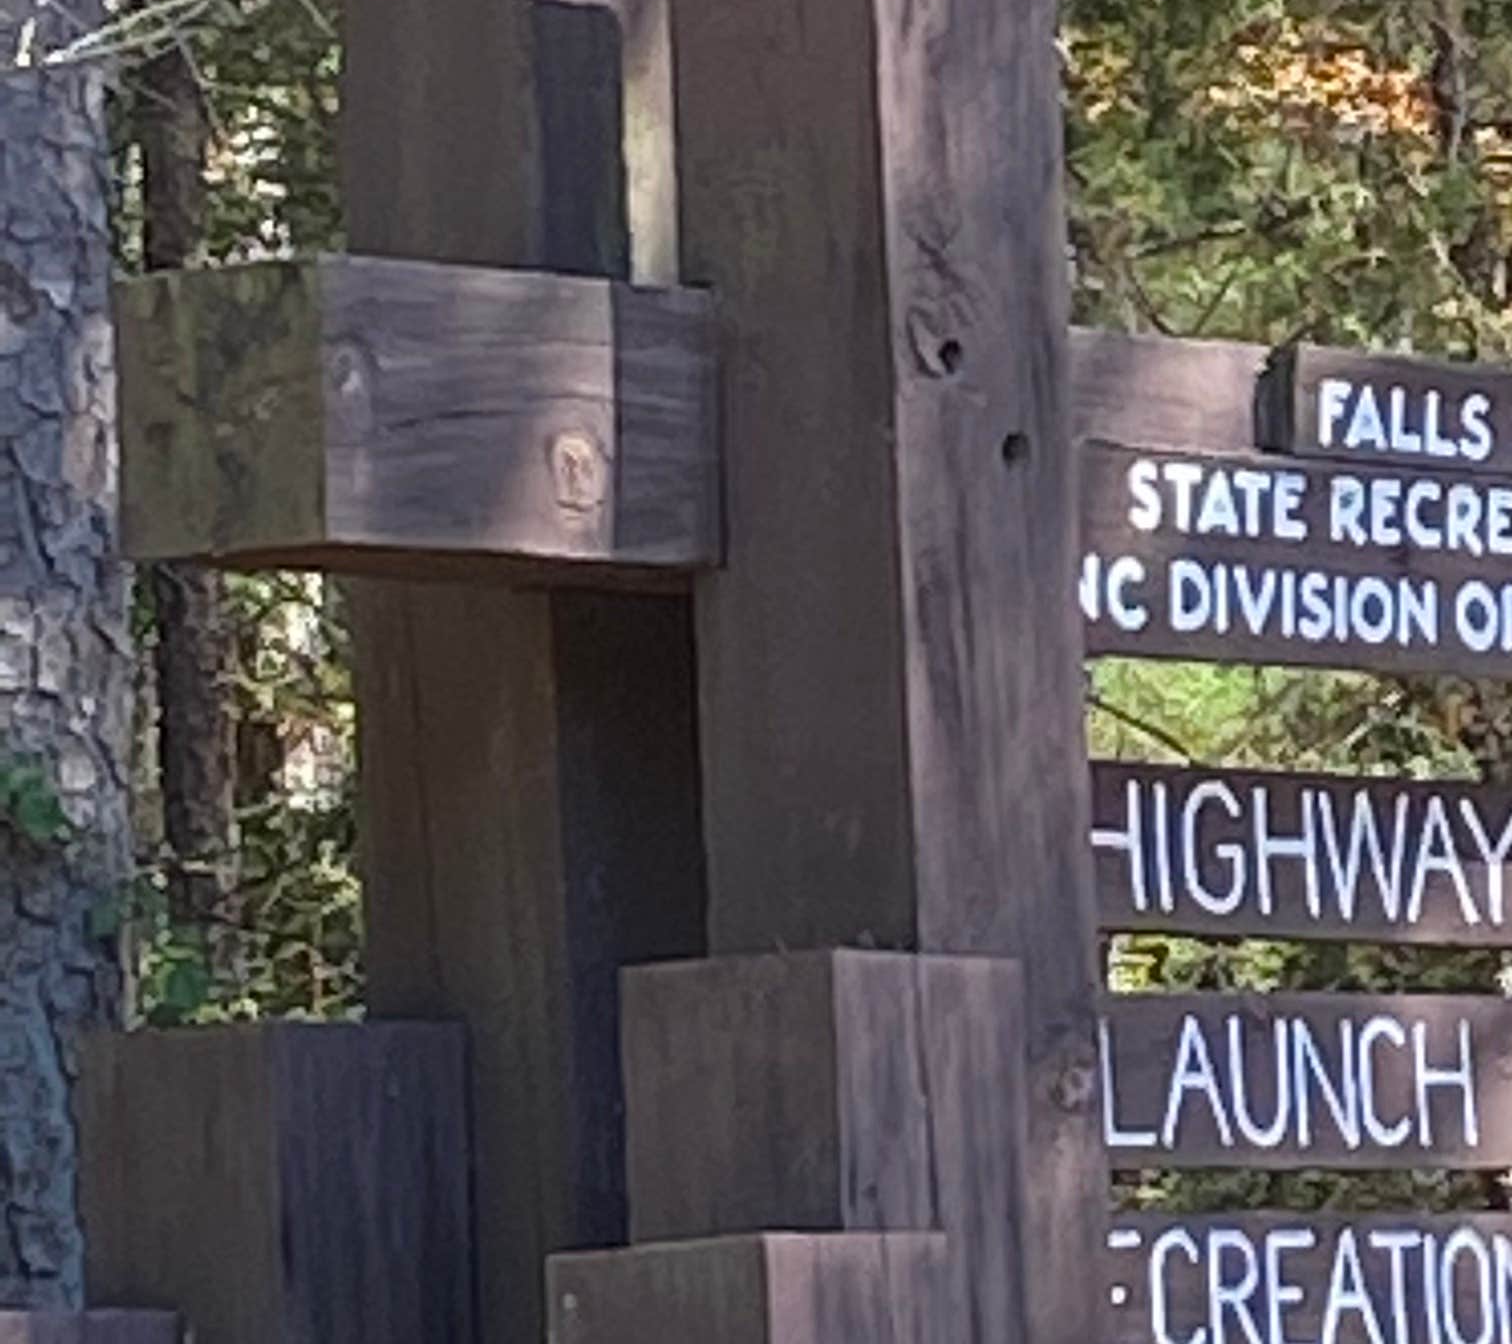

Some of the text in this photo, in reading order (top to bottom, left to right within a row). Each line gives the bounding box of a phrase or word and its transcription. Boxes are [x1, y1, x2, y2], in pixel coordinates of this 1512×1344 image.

[1318, 380, 1493, 461] FALLS
[1128, 462, 1306, 540] STATE
[1170, 562, 1437, 644] DIVISION
[1098, 1016, 1478, 1148] LAUNCH
